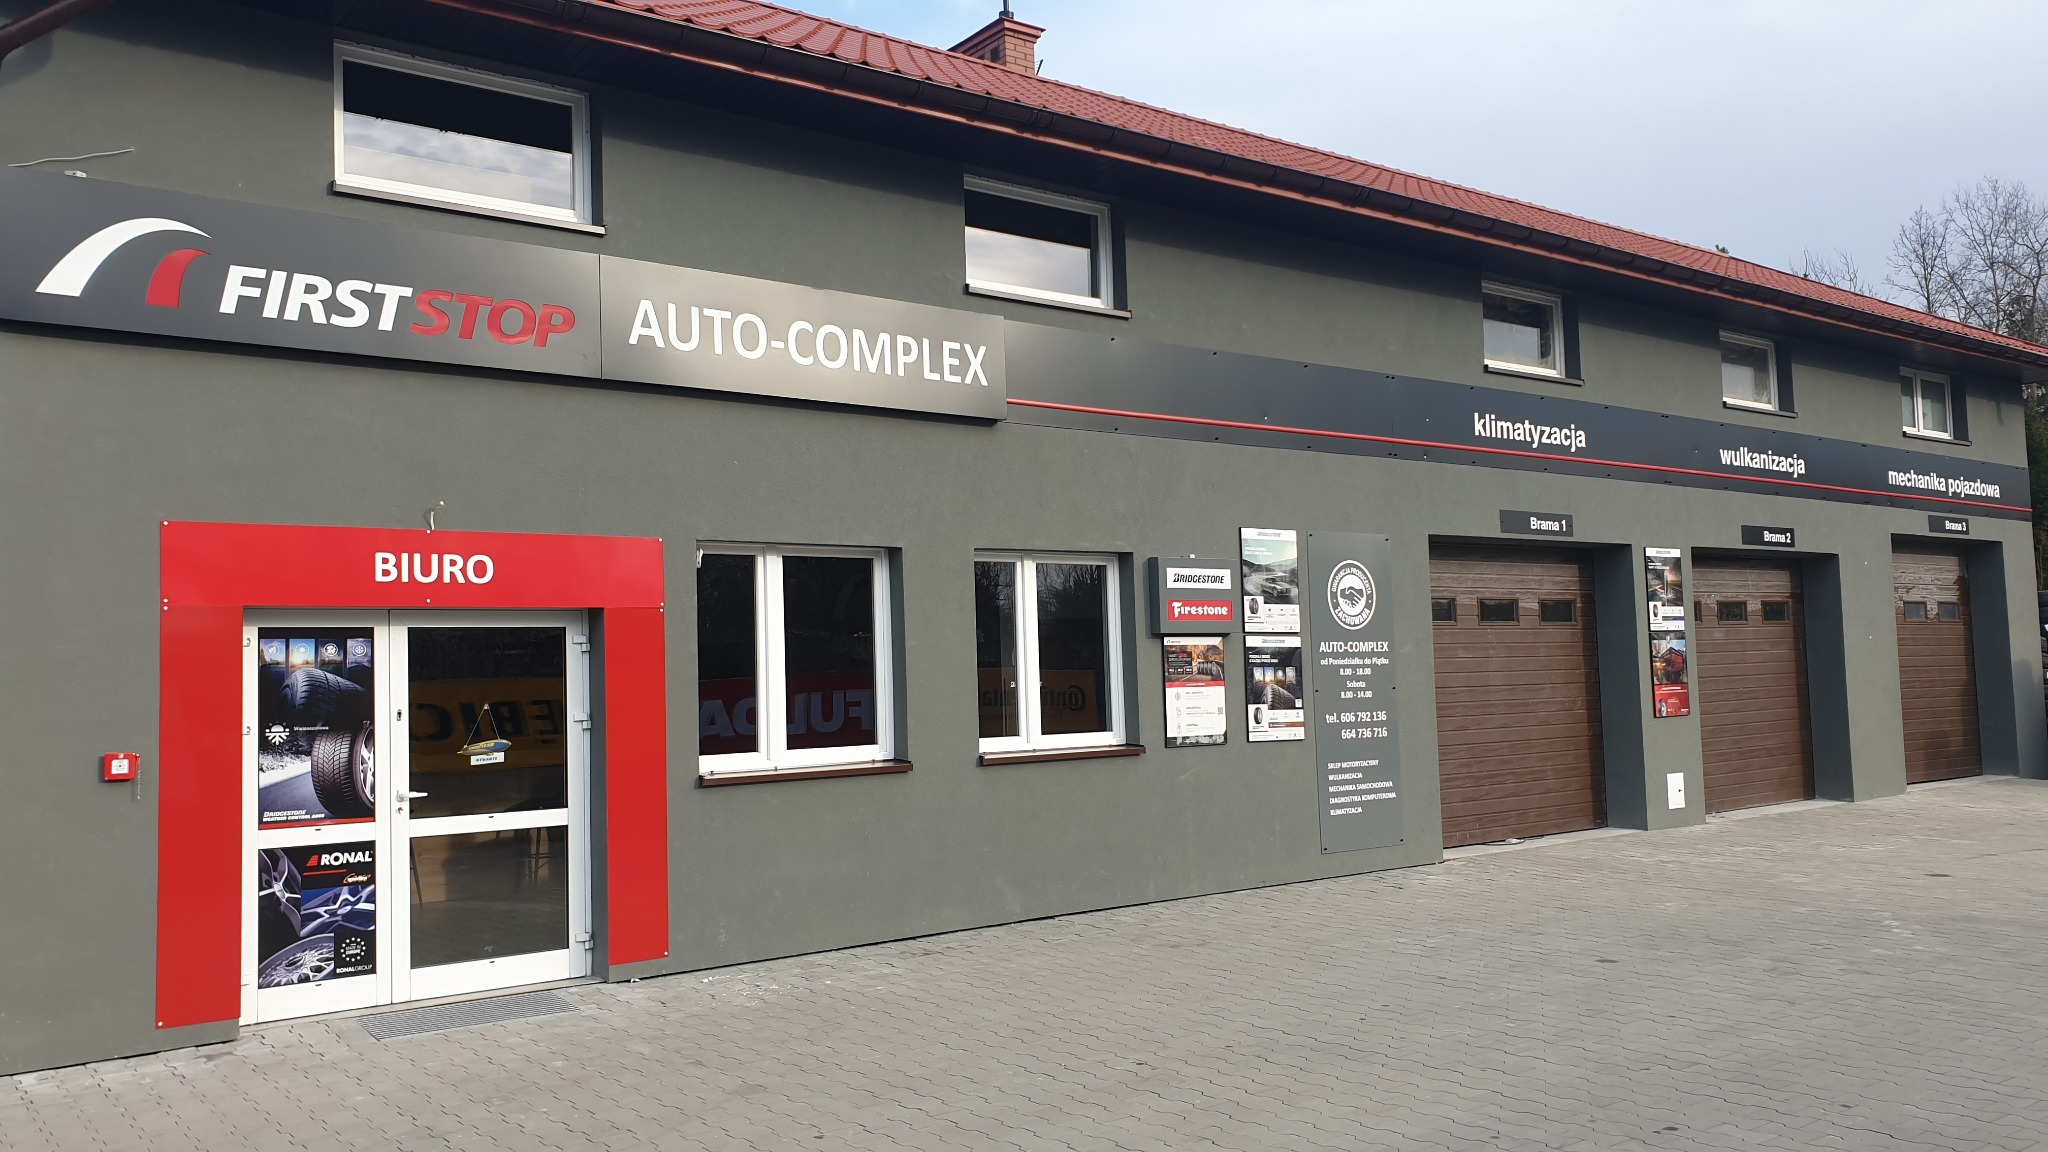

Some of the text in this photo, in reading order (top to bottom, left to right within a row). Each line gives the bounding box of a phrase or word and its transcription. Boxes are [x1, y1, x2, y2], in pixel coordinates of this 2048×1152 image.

[628, 298, 989, 387] AUTO-COMPLEX
[1473, 413, 1586, 452] klimatyzacja
[1719, 447, 1806, 477] wulkanizacja
[1888, 469, 2001, 498] mechanika pojazdowa
[1530, 516, 1567, 532] Brama 1
[1945, 519, 1967, 531] Brama 3
[1763, 530, 1792, 544] Brama 2
[374, 551, 495, 585] BIURO
[1173, 573, 1225, 584] BRIDGESTONE
[1172, 601, 1228, 618] Firestone
[1334, 606, 1371, 626] ZACHOWANA
[1319, 641, 1389, 653] AUTO-COMPLEX
[1364, 657, 1371, 665] do
[1356, 667, 1371, 675] 18.00
[1346, 680, 1366, 688] Sobota
[1357, 690, 1372, 698] 14.00
[1326, 710, 1387, 723] tel. 606 792 136
[1341, 726, 1387, 739] 664 736 716
[1328, 772, 1363, 780] WULKANIZACJA
[1328, 781, 1393, 792] MECHANIKA SAMOCHODOWA
[320, 851, 373, 866] RONAL
